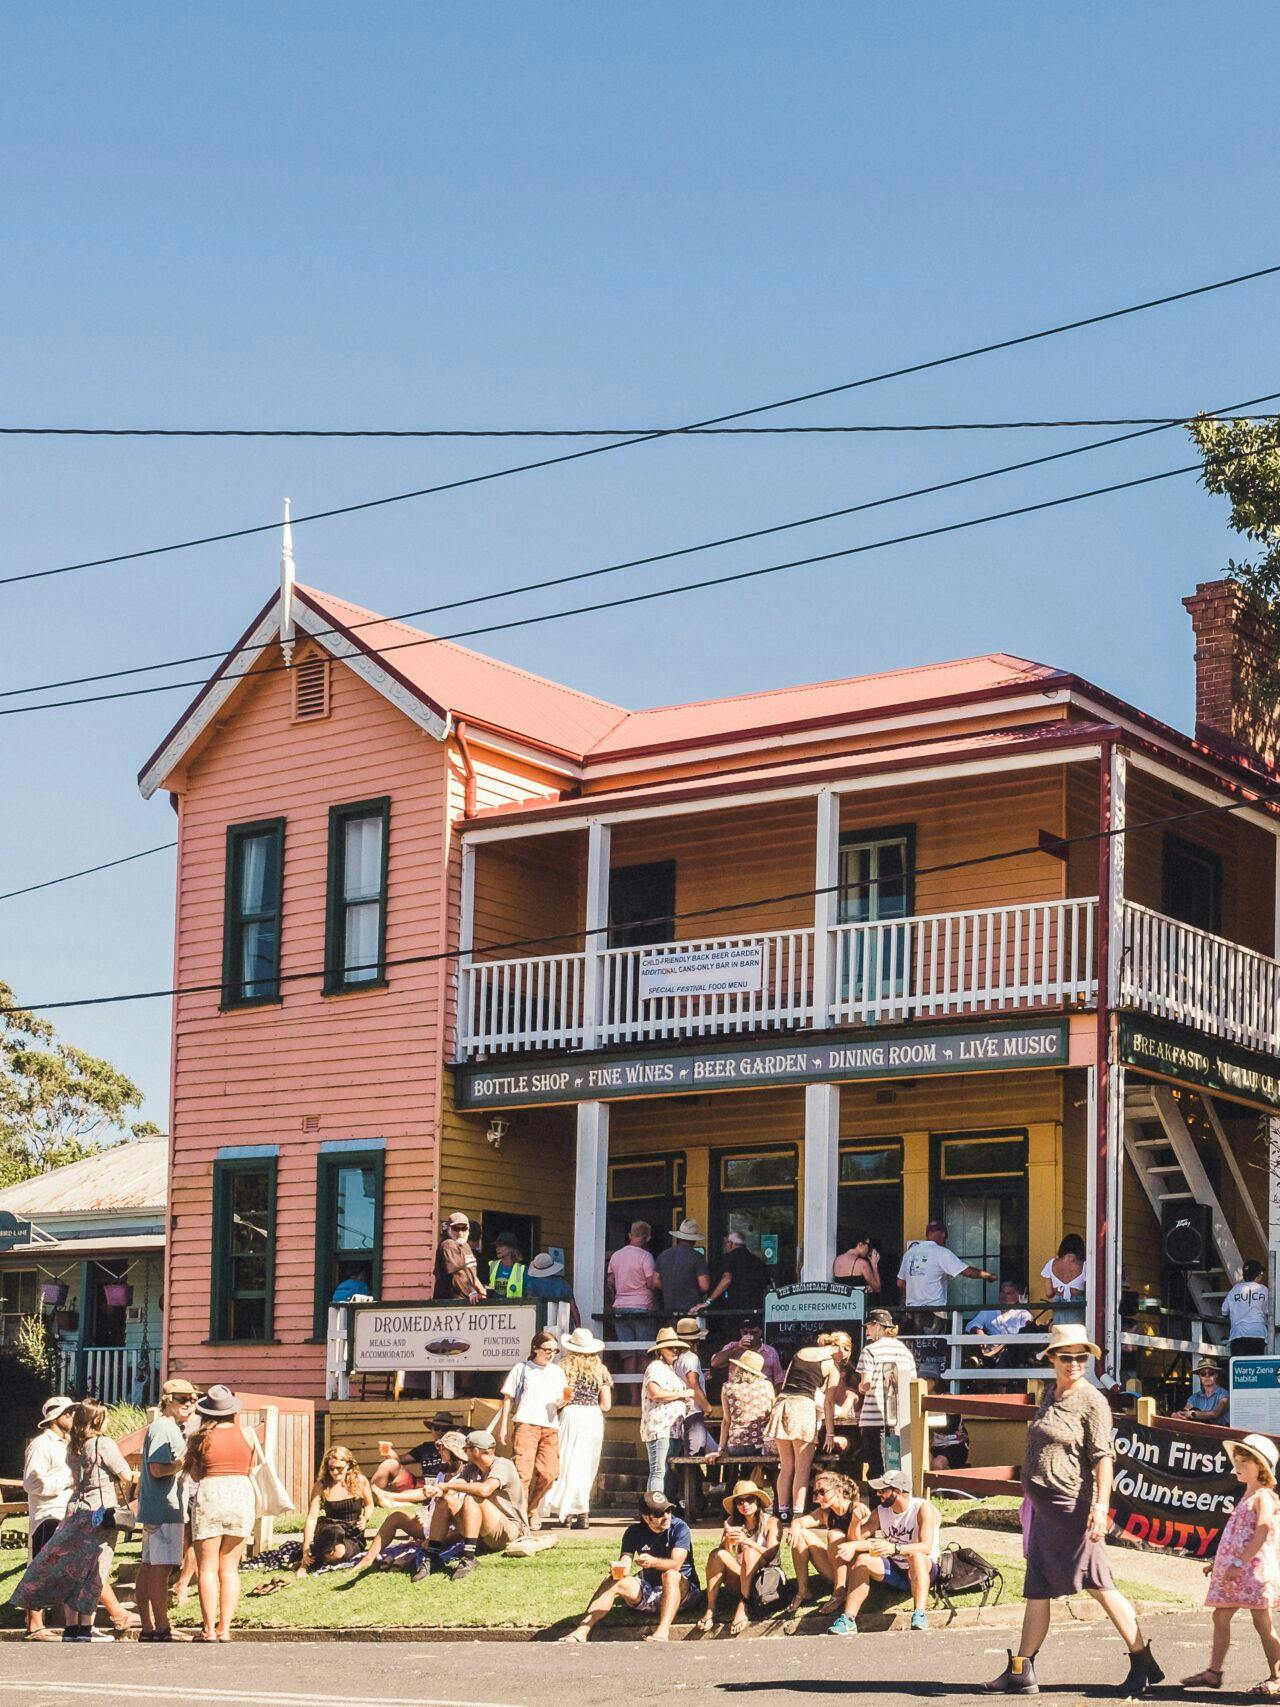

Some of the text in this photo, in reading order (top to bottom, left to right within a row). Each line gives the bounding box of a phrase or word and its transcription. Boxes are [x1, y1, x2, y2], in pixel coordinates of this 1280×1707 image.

[642, 949, 760, 967] CHILD-FRIENDLY BACK BEER GARDEN
[641, 966, 678, 976] ADDITIONAL
[678, 963, 714, 973] CANS-ONLY
[739, 959, 760, 968] BARN
[648, 981, 748, 995] SPECIAL FESTIVAL FOOD MENU
[474, 1034, 1057, 1097] BOTTLE SHOP FINE WINES BEER GARDEN DINING ROOM LIVE MUSIC
[1133, 1033, 1202, 1070] BREAKFAST
[1243, 1068, 1274, 1092] LUNCH
[778, 1282, 849, 1296] THE DROMEDARY HOTEL
[771, 1303, 790, 1312] FOOD
[798, 1302, 857, 1311] REFRESHMENTS
[374, 1312, 516, 1333] DROMEDARY HOTEL
[779, 1323, 797, 1332] LIVE
[369, 1338, 407, 1347] MEALS AND
[483, 1336, 521, 1345] FUNCTIONS
[360, 1350, 415, 1359] ACCOMMODATION
[482, 1348, 521, 1357] COLD BEER
[1234, 1367, 1256, 1375] Warty
[1168, 1441, 1227, 1474] First
[1112, 1469, 1235, 1514] Volunteers
[1124, 1513, 1220, 1556] DUTY
